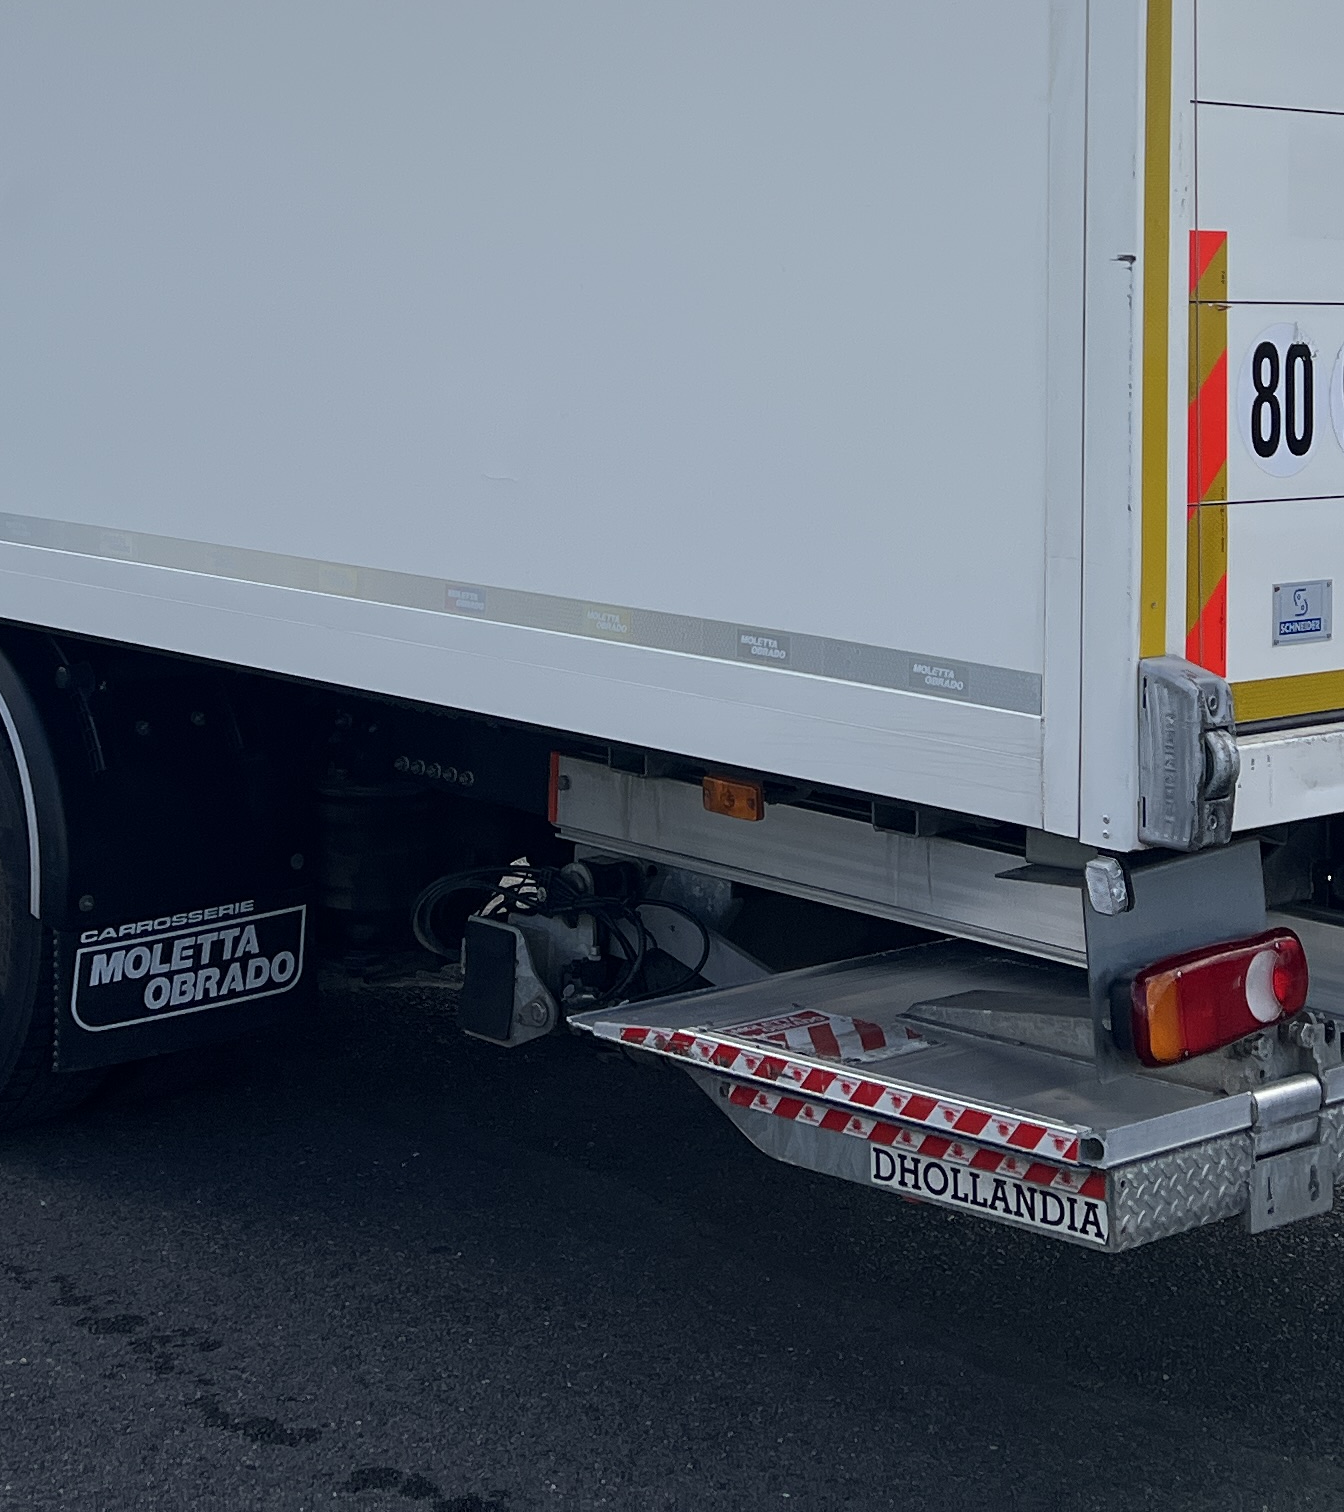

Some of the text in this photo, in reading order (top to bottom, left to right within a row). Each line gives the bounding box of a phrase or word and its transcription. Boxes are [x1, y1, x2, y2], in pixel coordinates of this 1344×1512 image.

[1251, 341, 1314, 458] 80
[1280, 619, 1320, 634] SCHNEIDER
[80, 899, 255, 944] CARROSSERIE
[89, 924, 260, 987] MOLETTA
[143, 950, 295, 1010] OBRADO
[872, 1146, 1106, 1241] DHOLLANDIA
